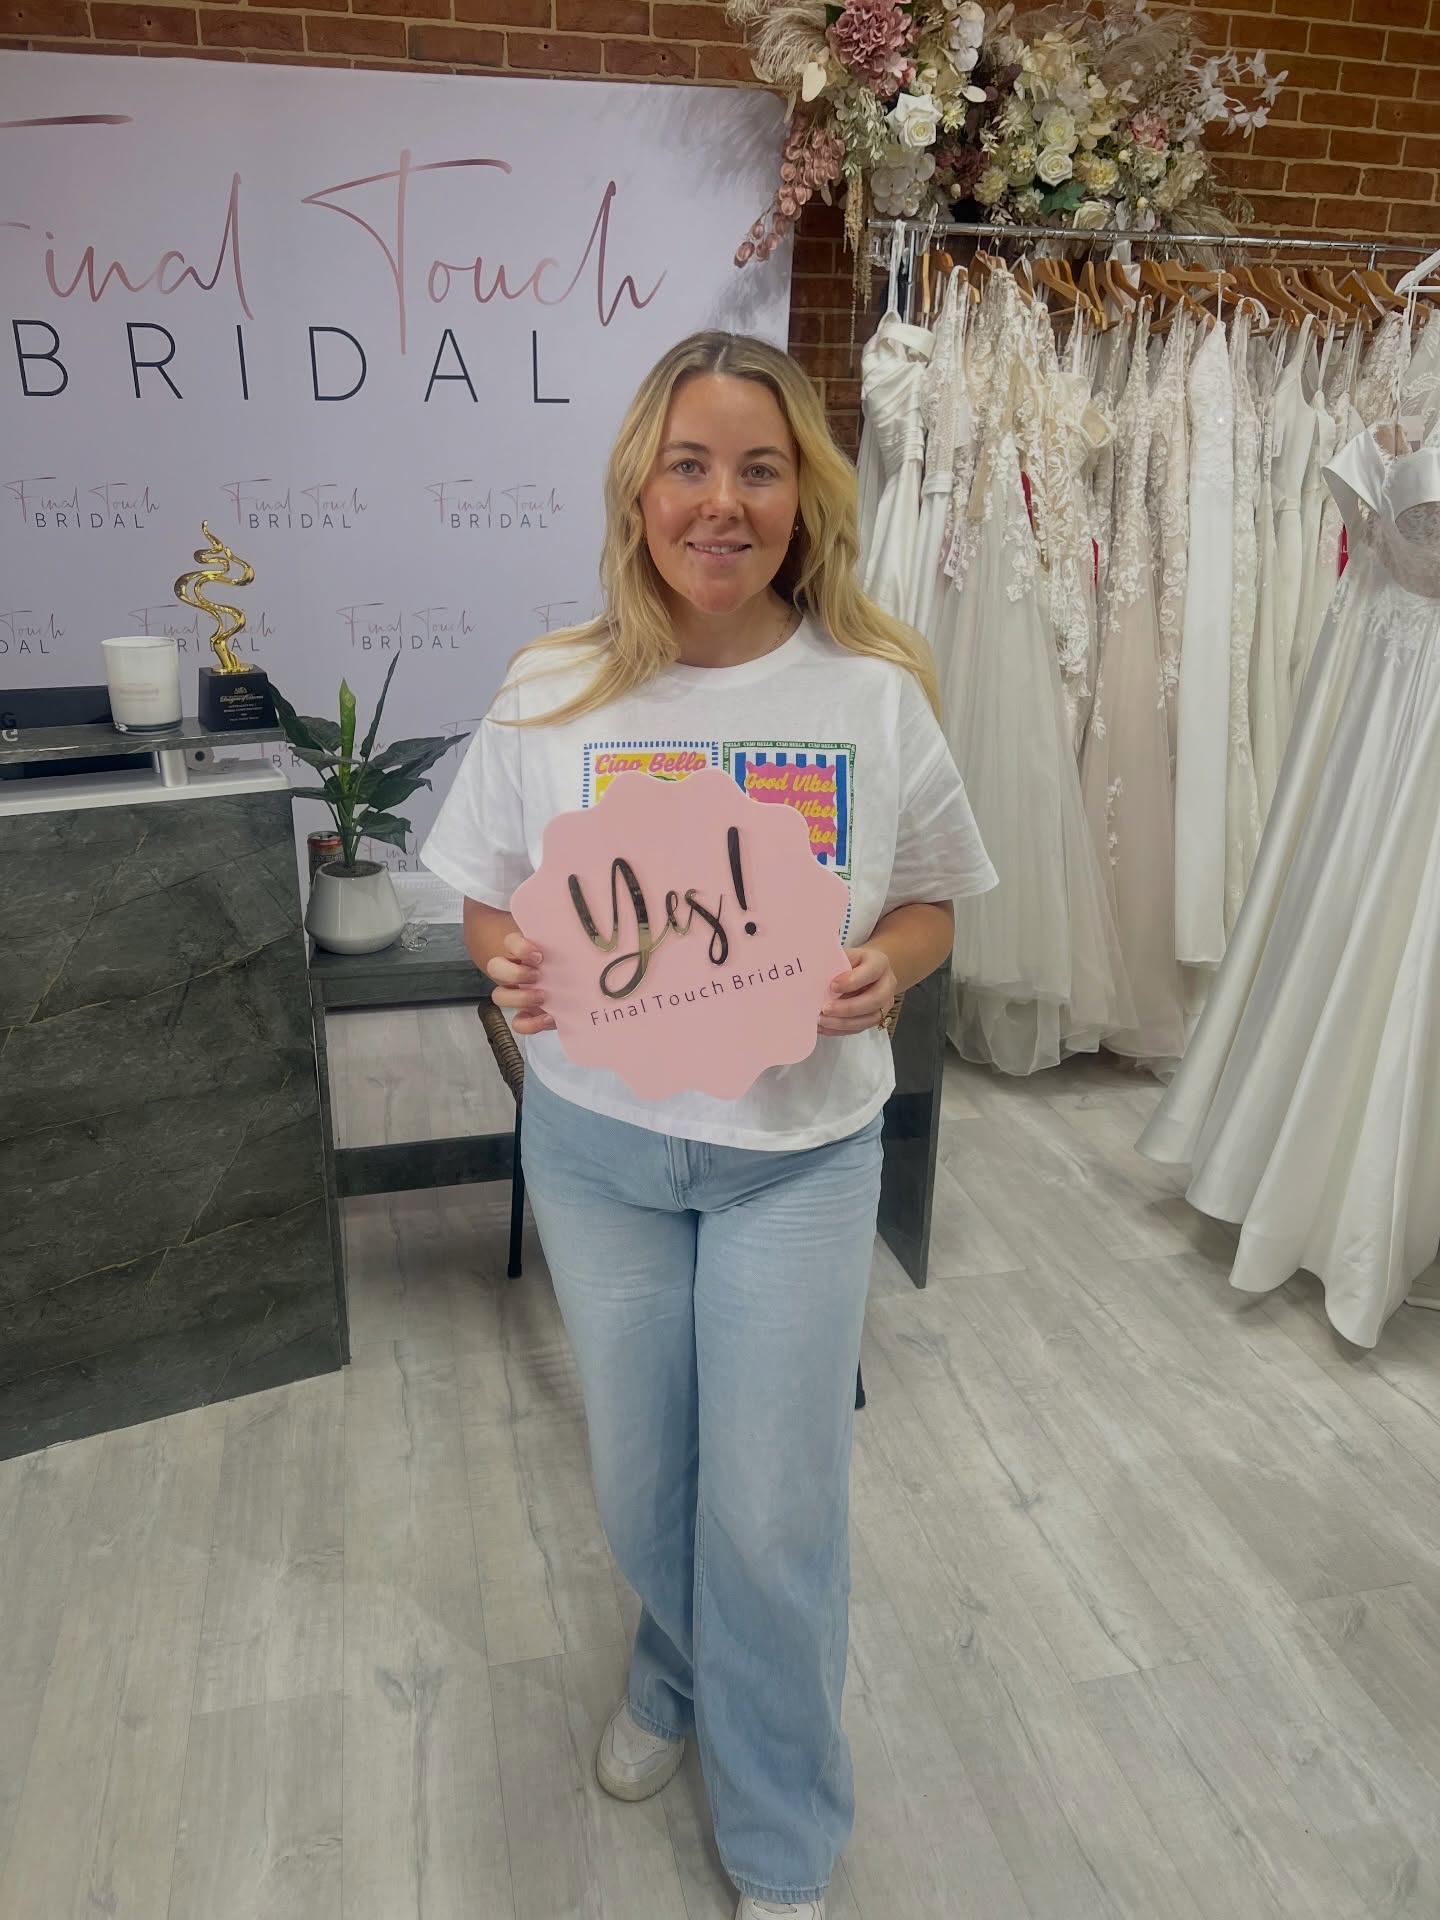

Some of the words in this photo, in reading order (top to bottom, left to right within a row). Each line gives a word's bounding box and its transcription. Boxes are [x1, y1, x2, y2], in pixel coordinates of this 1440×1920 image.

[301, 149, 667, 355] Touch
[12, 319, 570, 404] BRIDAL
[2, 476, 80, 523] Final
[88, 481, 161, 520] Touch
[219, 478, 292, 525] Final
[301, 483, 368, 520] Touch
[424, 479, 492, 523] Final
[501, 484, 565, 520] Touch
[35, 512, 145, 529] BRIDAL
[249, 513, 352, 529] BRIDAL
[450, 513, 548, 529] BRIDAL
[336, 602, 402, 646] Final
[411, 607, 477, 641] Touch
[362, 635, 460, 650] BRIDAL
[757, 740, 774, 748] BELLA
[595, 753, 643, 775] Ciao
[647, 751, 707, 772] Bella
[744, 772, 790, 791] Good
[590, 999, 647, 1026] Final
[651, 980, 725, 1009] Touch
[731, 957, 803, 990] Bridal
